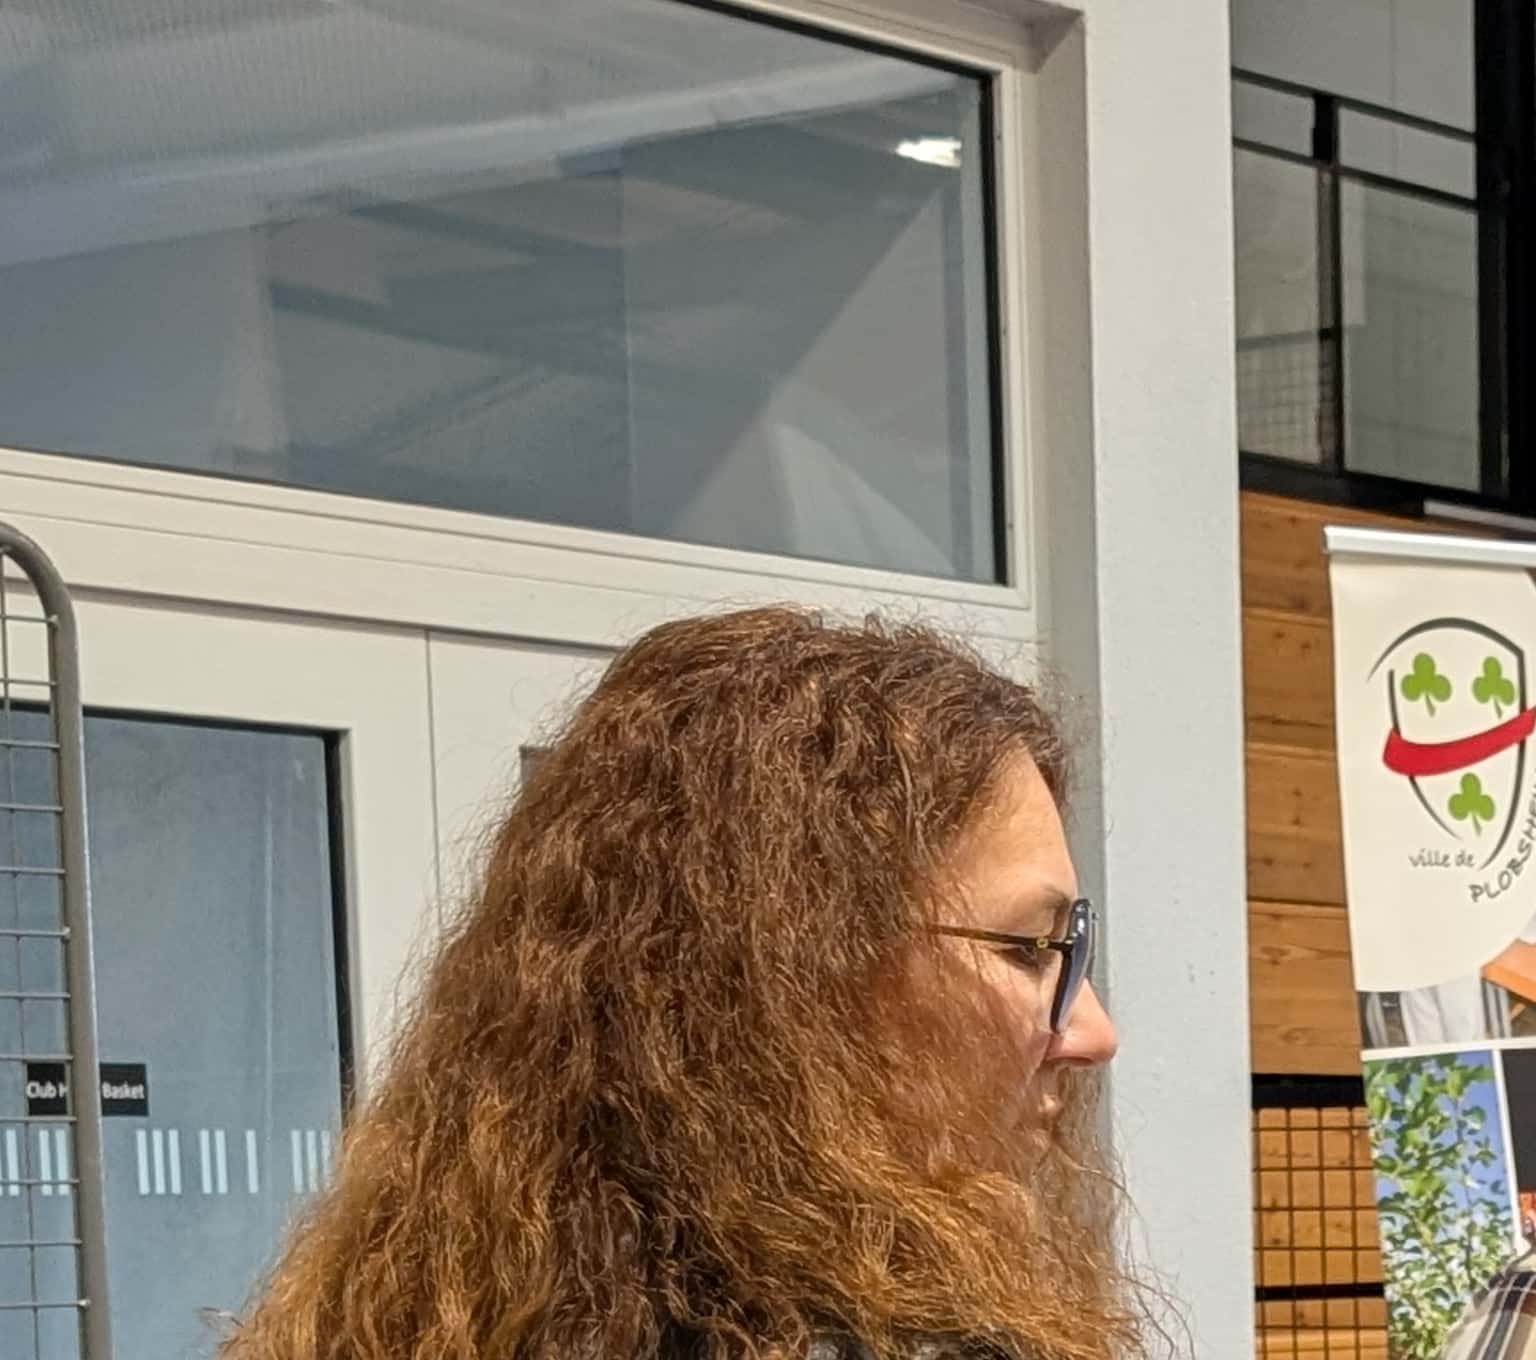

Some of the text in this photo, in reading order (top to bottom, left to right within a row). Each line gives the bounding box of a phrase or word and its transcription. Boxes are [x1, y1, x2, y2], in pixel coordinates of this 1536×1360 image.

[1408, 848, 1475, 868] ville de
[26, 1080, 57, 1099] Club
[101, 1080, 145, 1100] Basket
